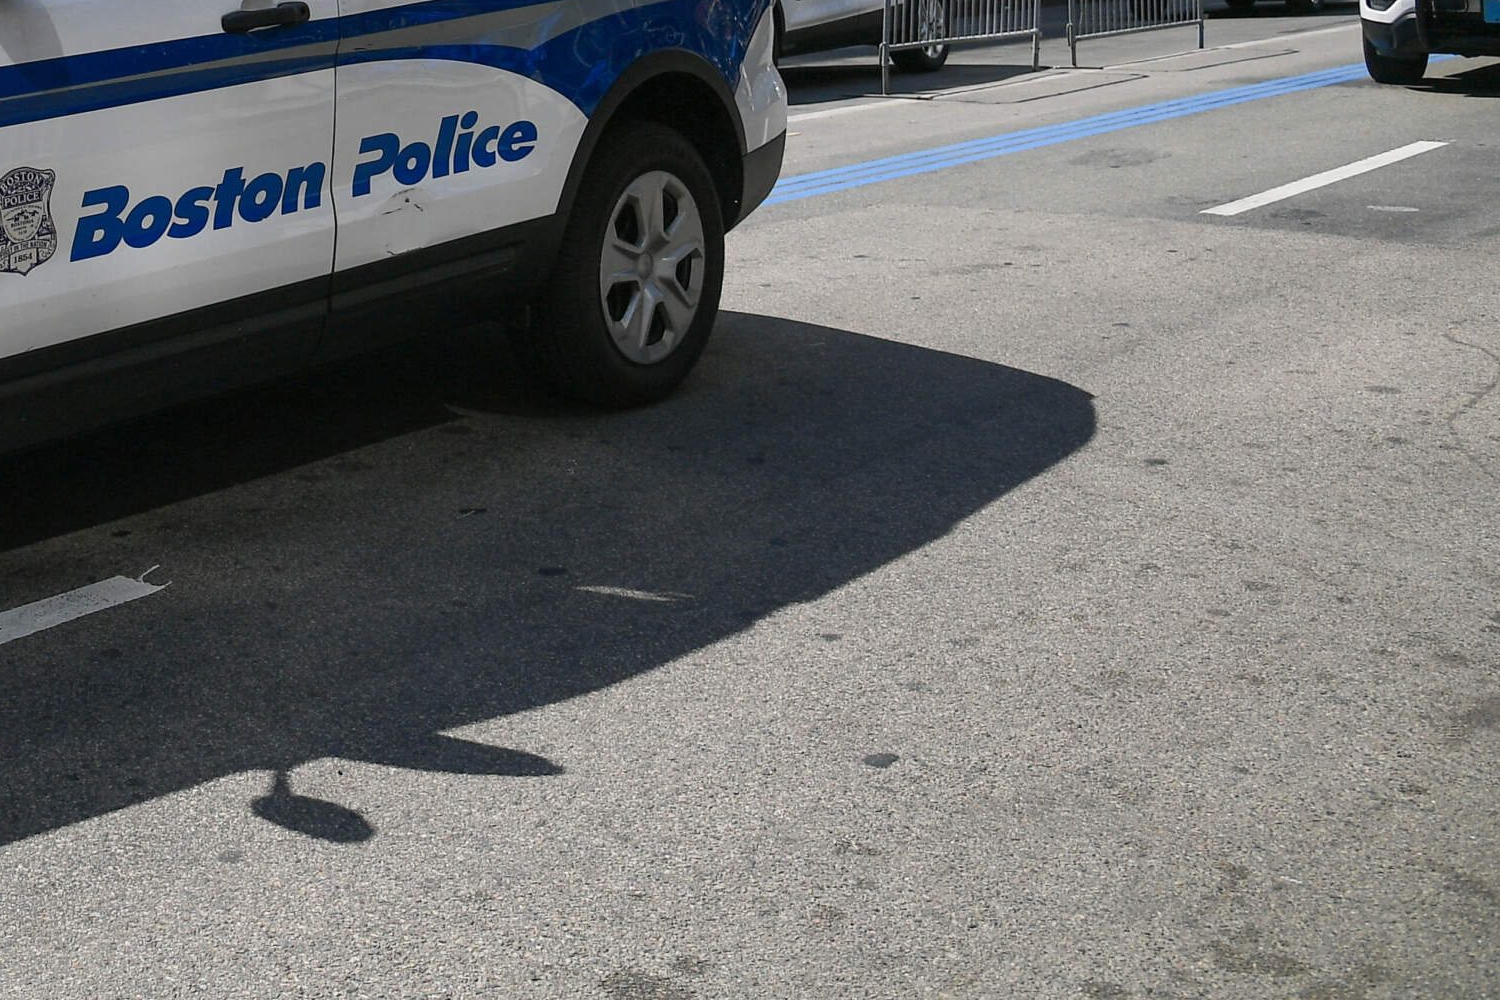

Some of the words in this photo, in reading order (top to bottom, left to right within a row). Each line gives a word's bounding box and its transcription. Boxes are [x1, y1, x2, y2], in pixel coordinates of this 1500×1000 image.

[1, 171, 43, 190] BOSTON
[70, 161, 326, 263] Boston
[352, 110, 539, 198] Police
[4, 192, 40, 206] POLICE
[13, 252, 33, 264] 1854
